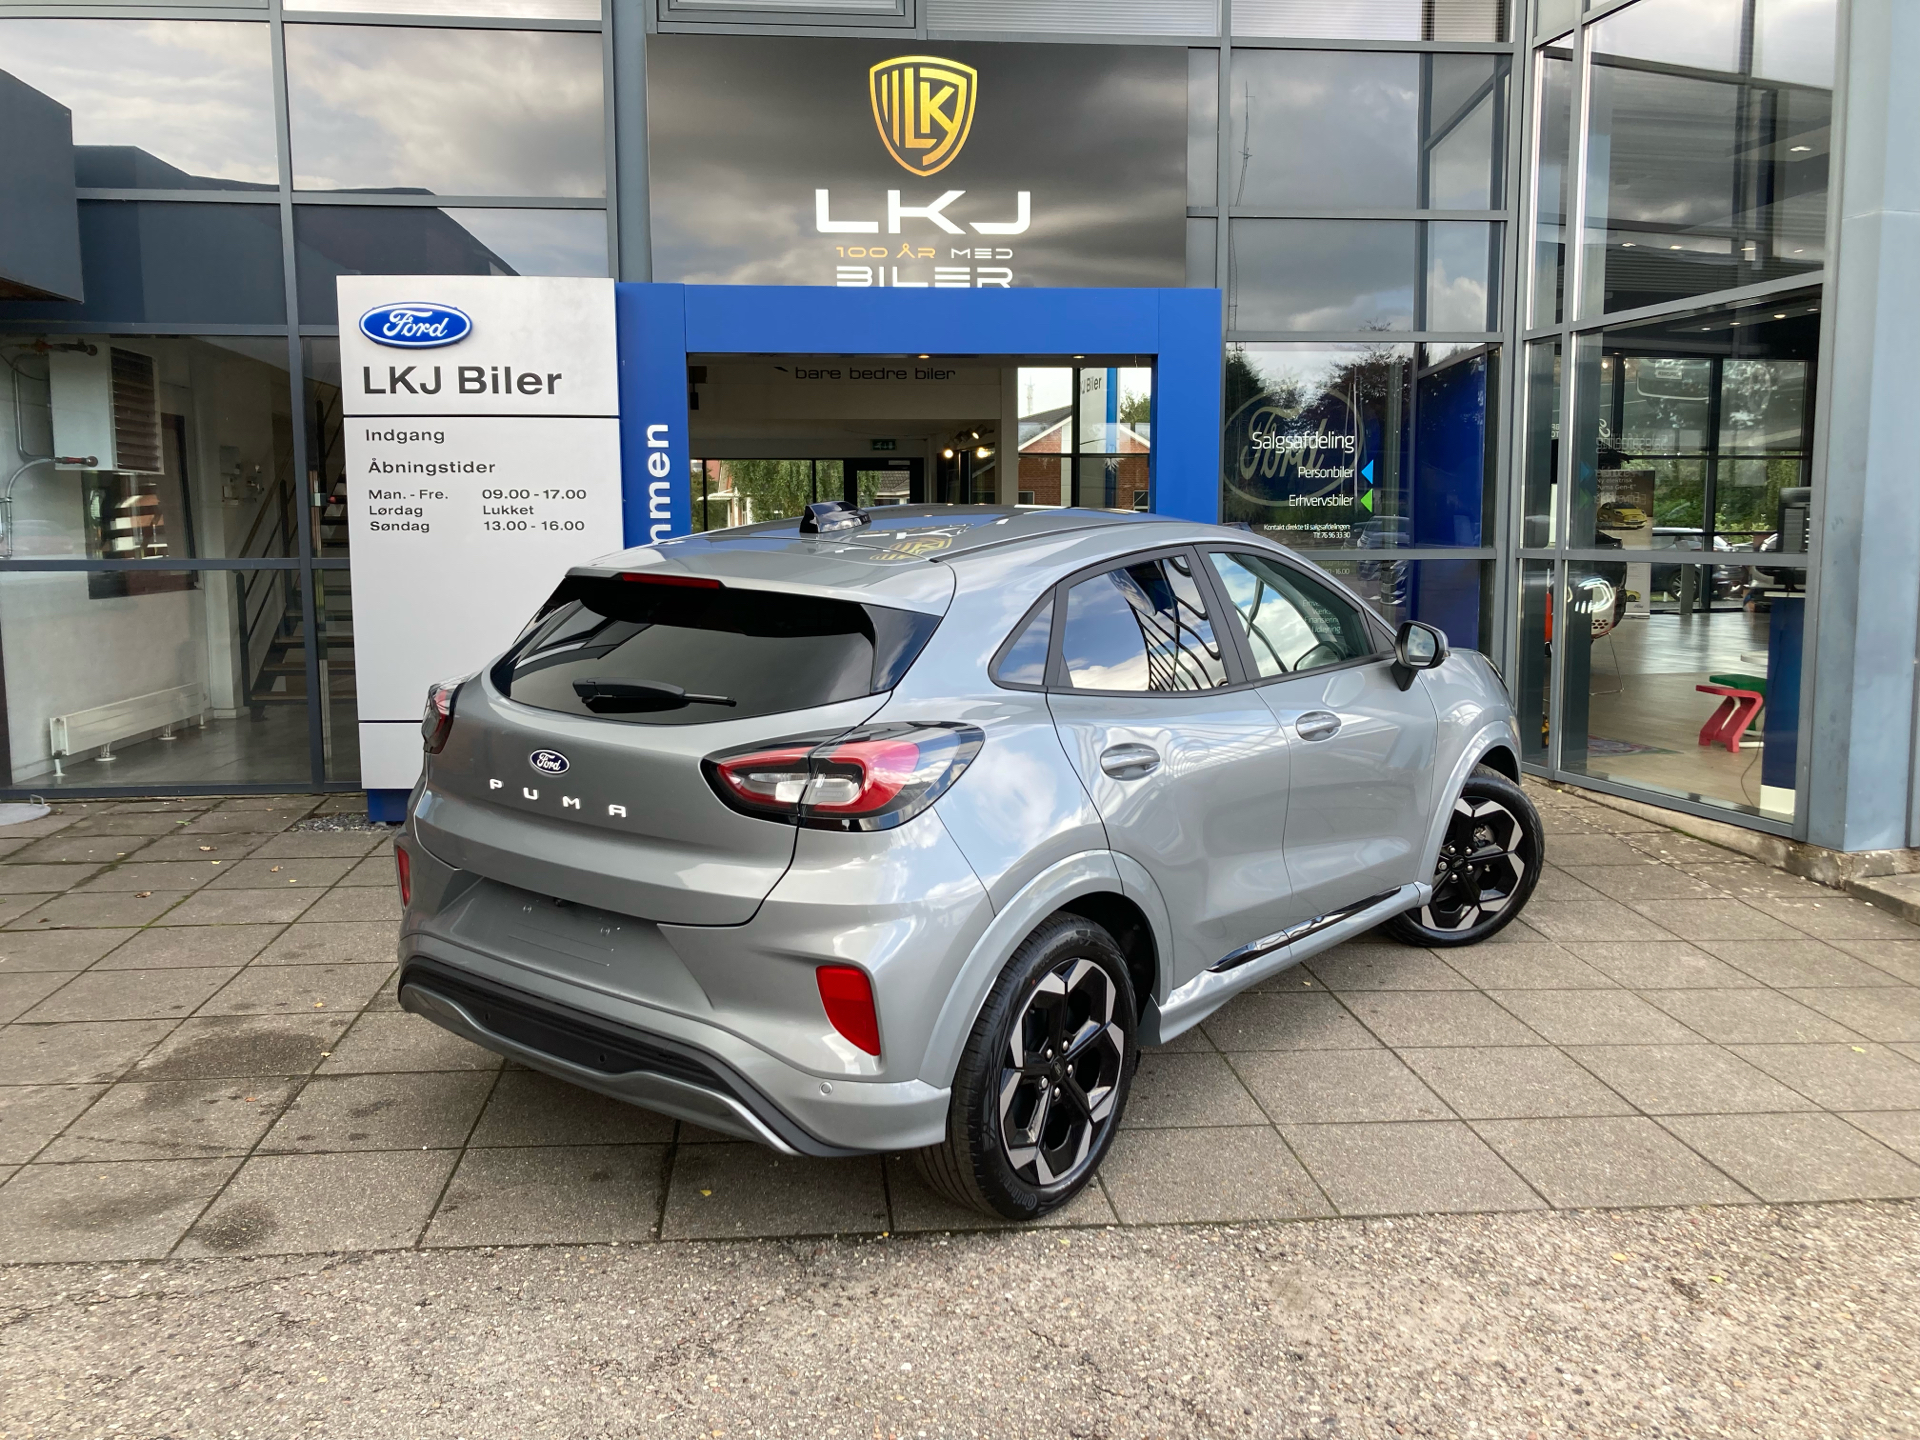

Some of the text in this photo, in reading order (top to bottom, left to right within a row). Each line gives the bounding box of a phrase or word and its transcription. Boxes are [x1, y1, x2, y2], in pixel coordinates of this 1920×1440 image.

[815, 189, 1031, 234] LKJ
[836, 243, 1013, 259] 100 ÅR MED
[836, 265, 1013, 288] BILER
[383, 310, 449, 338] Ford
[362, 366, 562, 395] LKJ Biler
[795, 366, 956, 380] bare bedre biler
[365, 428, 445, 444] Indgang
[1240, 406, 1328, 481] Ford
[1252, 431, 1354, 453] Salgsafdeling
[368, 457, 496, 476] Åbningstider
[1298, 466, 1354, 478] Personbiler
[368, 489, 407, 500] Man.
[419, 489, 449, 500] Fre.
[482, 489, 530, 500] 09.00
[544, 489, 587, 500] 17.00
[1289, 494, 1354, 507] Erhvervsbiler
[369, 505, 534, 518] Lørdag Lukket
[370, 521, 430, 533] Søndag
[484, 521, 527, 531] 13.00
[541, 521, 585, 531] 16.00
[537, 752, 561, 771] Ford
[489, 778, 627, 818] PUMA
